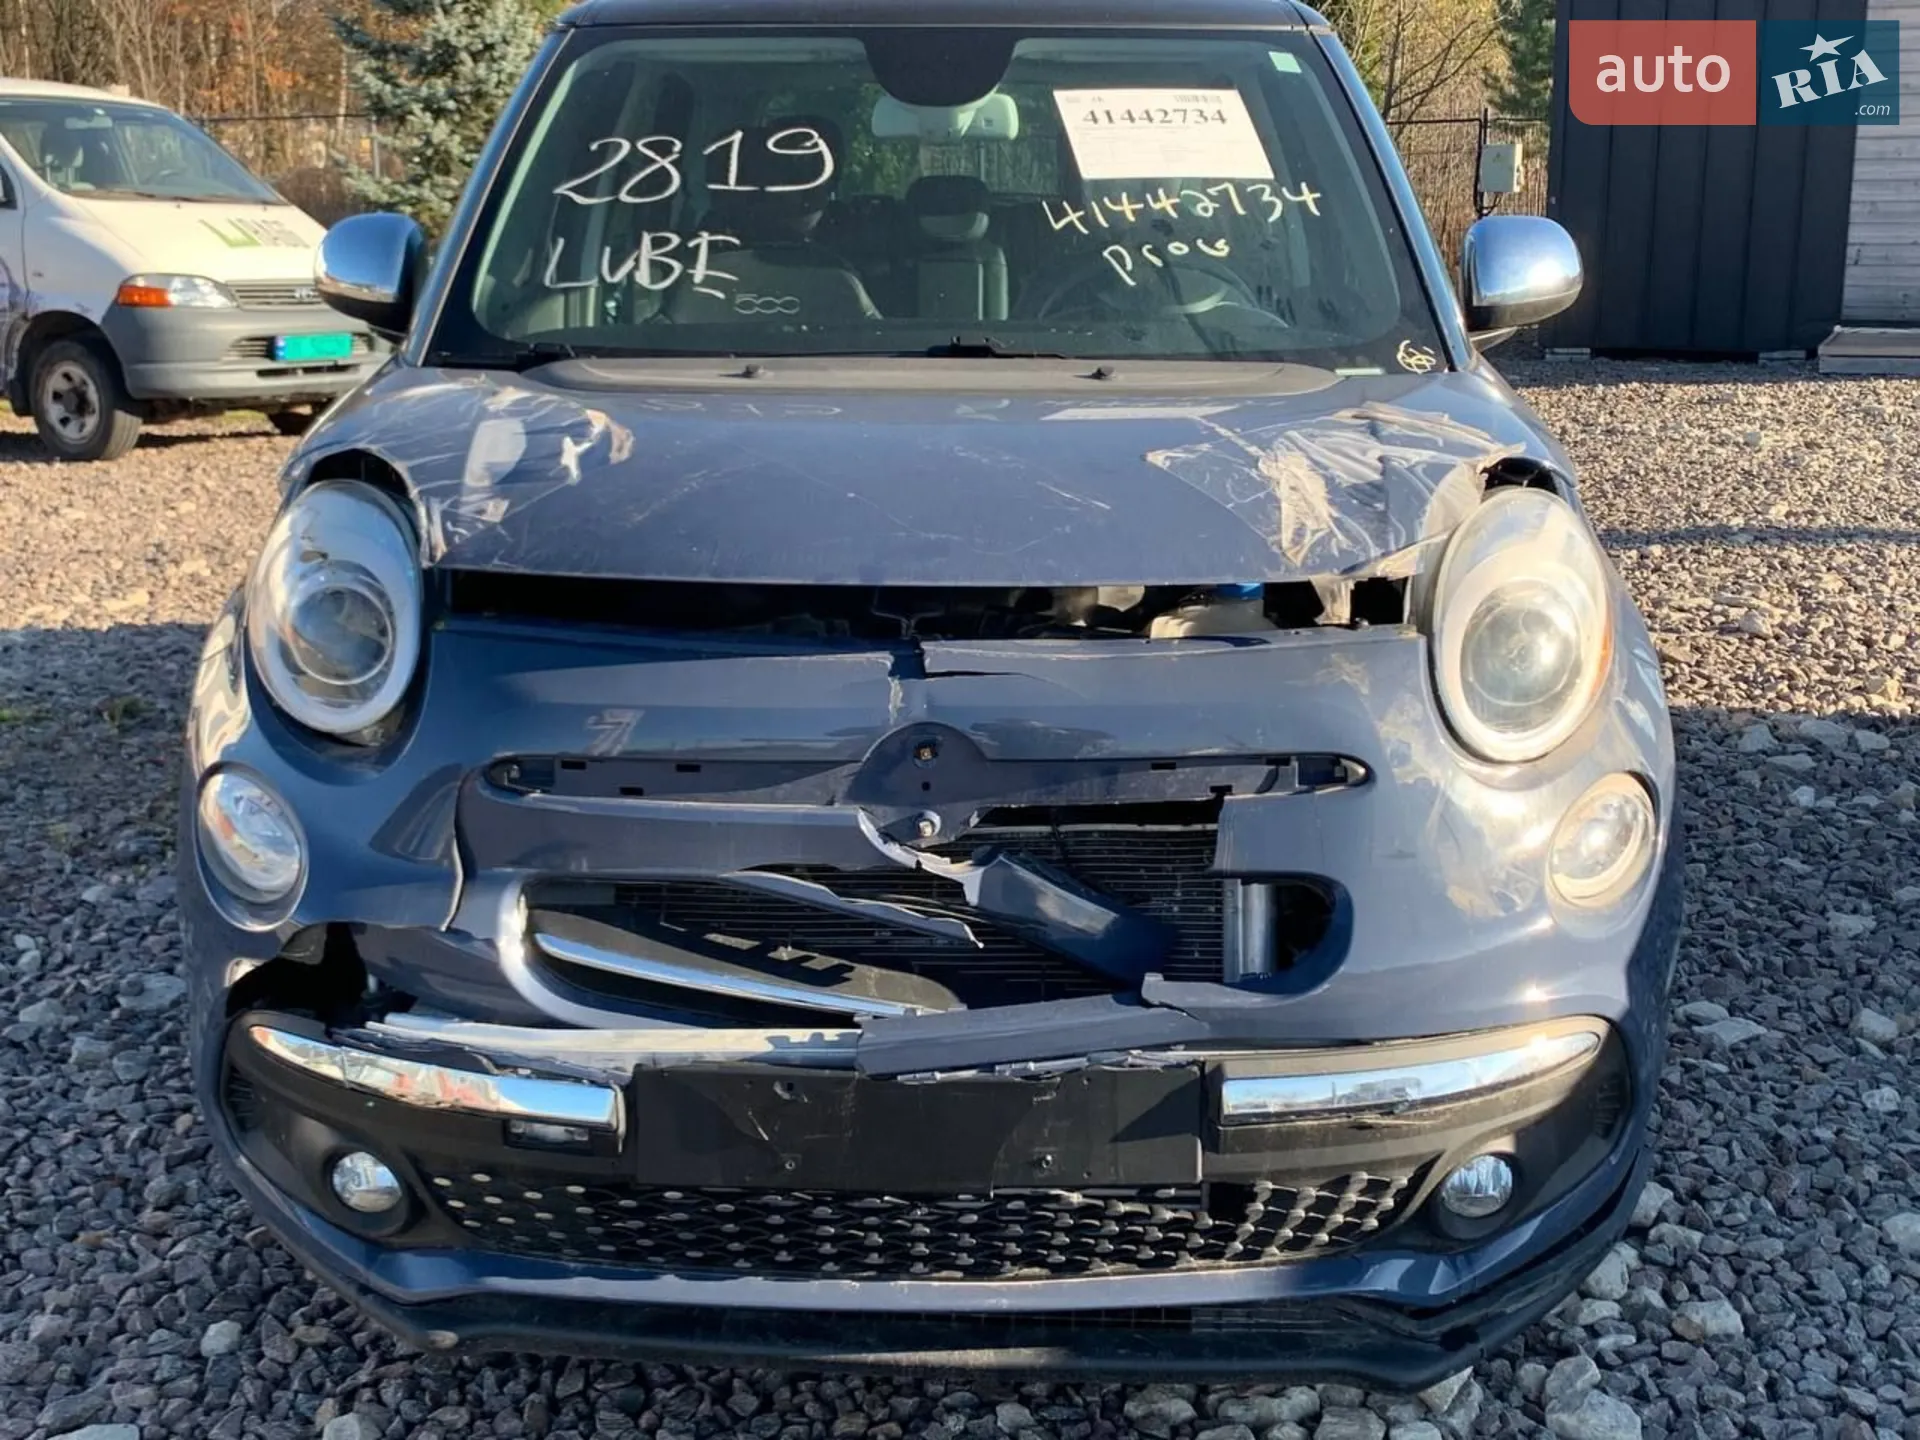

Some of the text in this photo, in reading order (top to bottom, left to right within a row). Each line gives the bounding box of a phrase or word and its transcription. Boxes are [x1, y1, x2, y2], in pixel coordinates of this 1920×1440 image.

[1082, 108, 1228, 125] 41442734
[552, 127, 835, 205] 2819
[1042, 181, 1322, 235] 41442734
